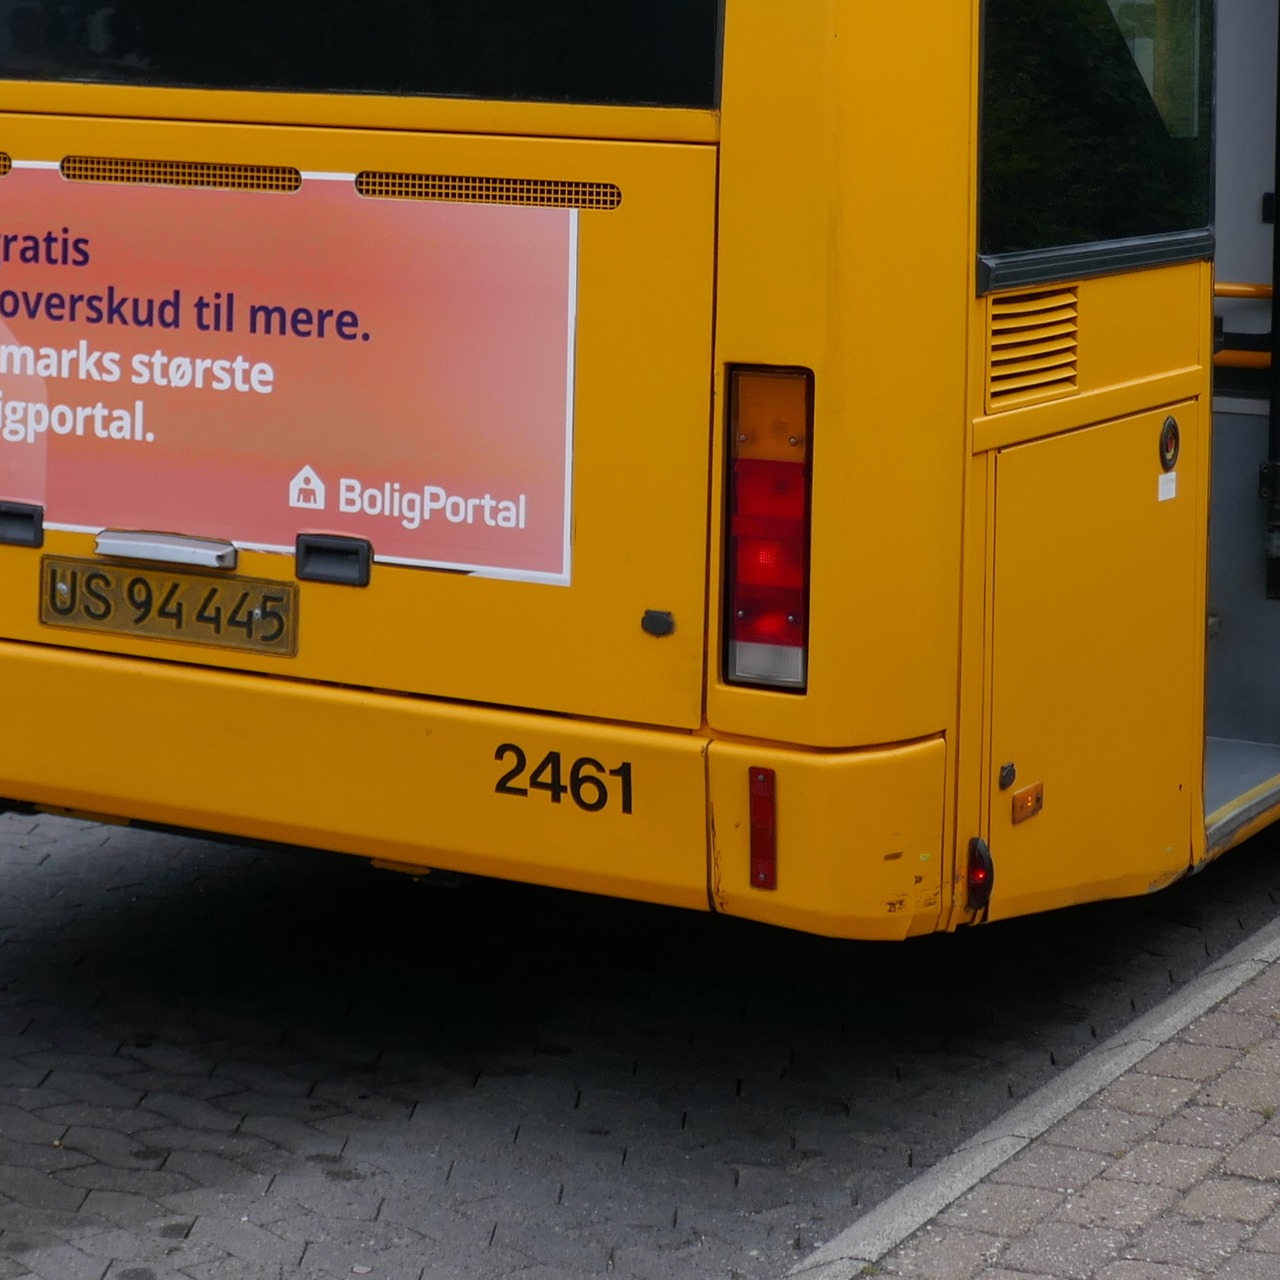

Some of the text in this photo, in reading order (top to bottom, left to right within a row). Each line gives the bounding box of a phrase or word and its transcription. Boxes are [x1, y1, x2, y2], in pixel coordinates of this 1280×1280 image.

[193, 291, 235, 333] til
[248, 304, 371, 343] mere.
[130, 349, 275, 395] største
[338, 477, 527, 530] BoligPortal
[48, 568, 286, 643] US 94 445
[493, 742, 634, 816] 2461
